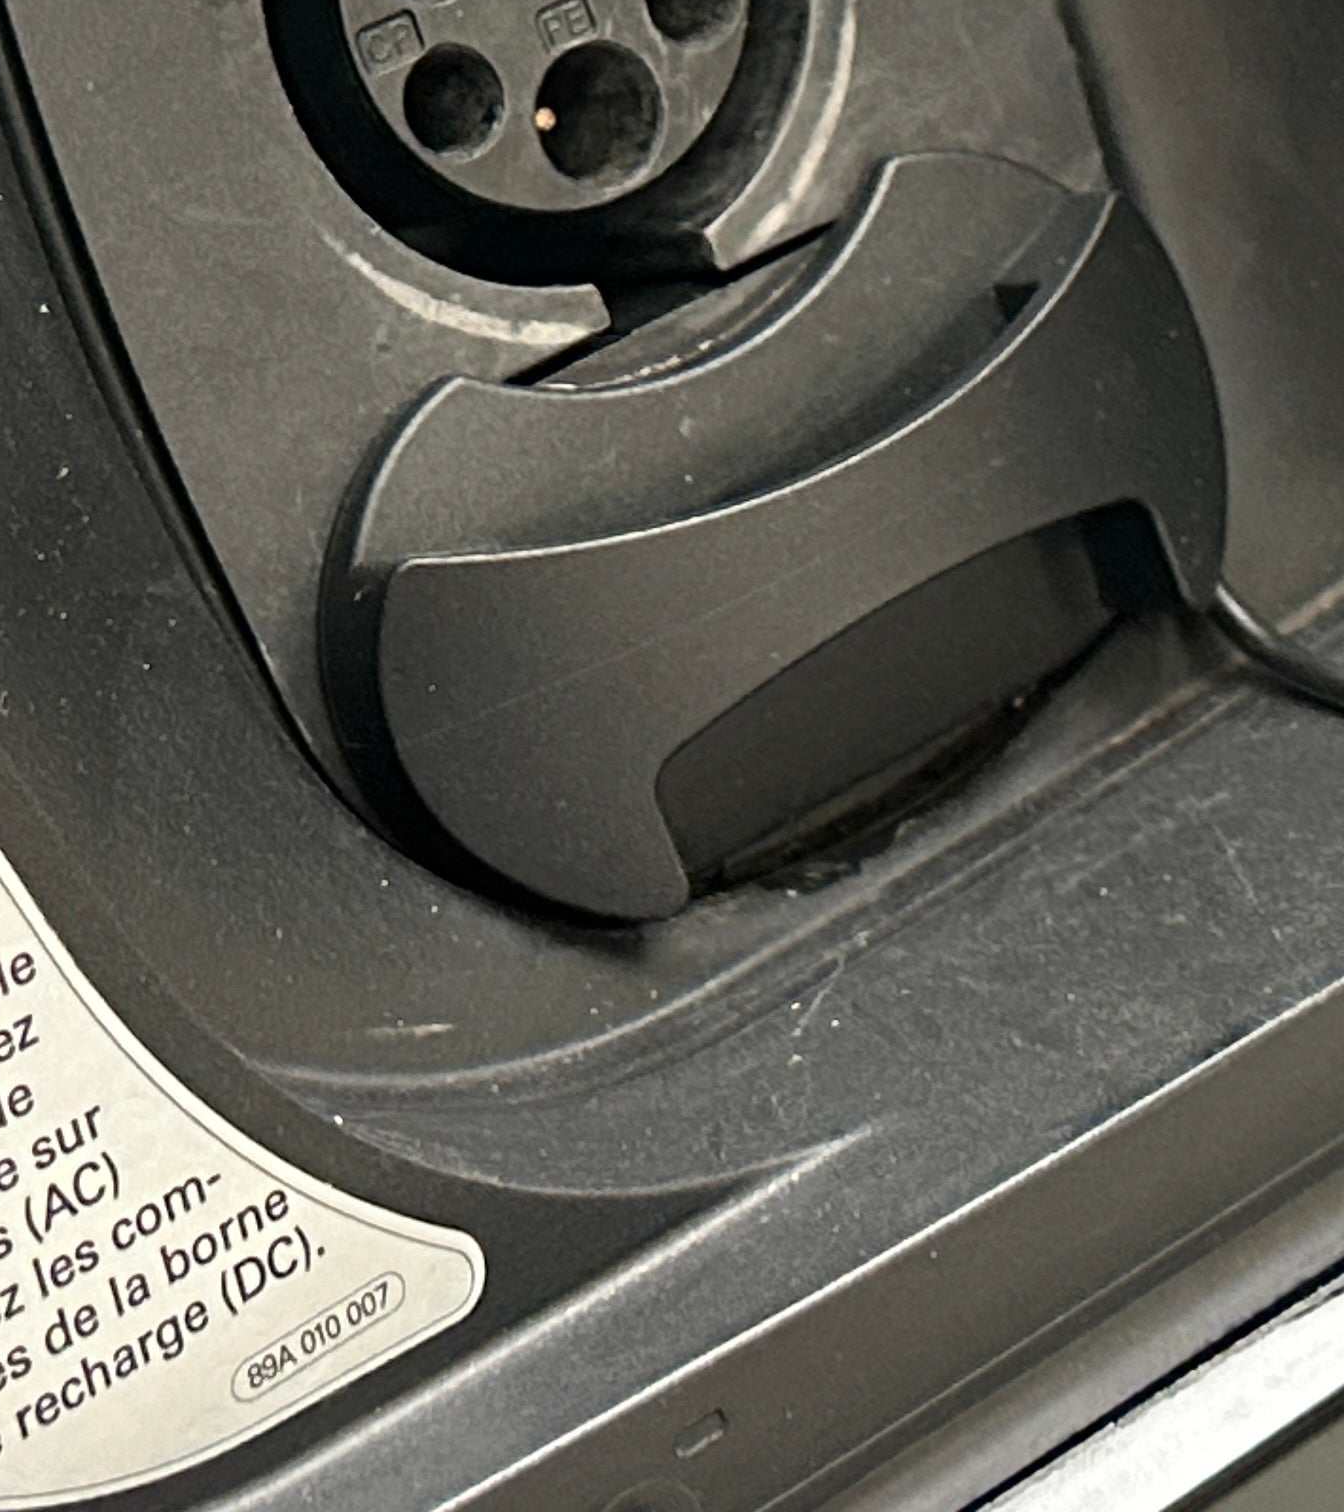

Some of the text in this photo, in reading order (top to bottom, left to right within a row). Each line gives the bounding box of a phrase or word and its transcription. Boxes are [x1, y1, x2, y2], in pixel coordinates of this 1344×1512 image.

[366, 24, 414, 65] CP
[542, 7, 592, 47] PE
[32, 1105, 100, 1170] sur
[25, 1152, 119, 1244] (AC)
[33, 1240, 99, 1298] les
[112, 1173, 221, 1250] com-
[45, 1304, 99, 1355] de
[109, 1274, 151, 1317] la
[160, 1190, 289, 1285] borne
[16, 1301, 208, 1440] recharge
[221, 1226, 325, 1317] (DC).
[246, 1281, 388, 1389] 89A 010 007
